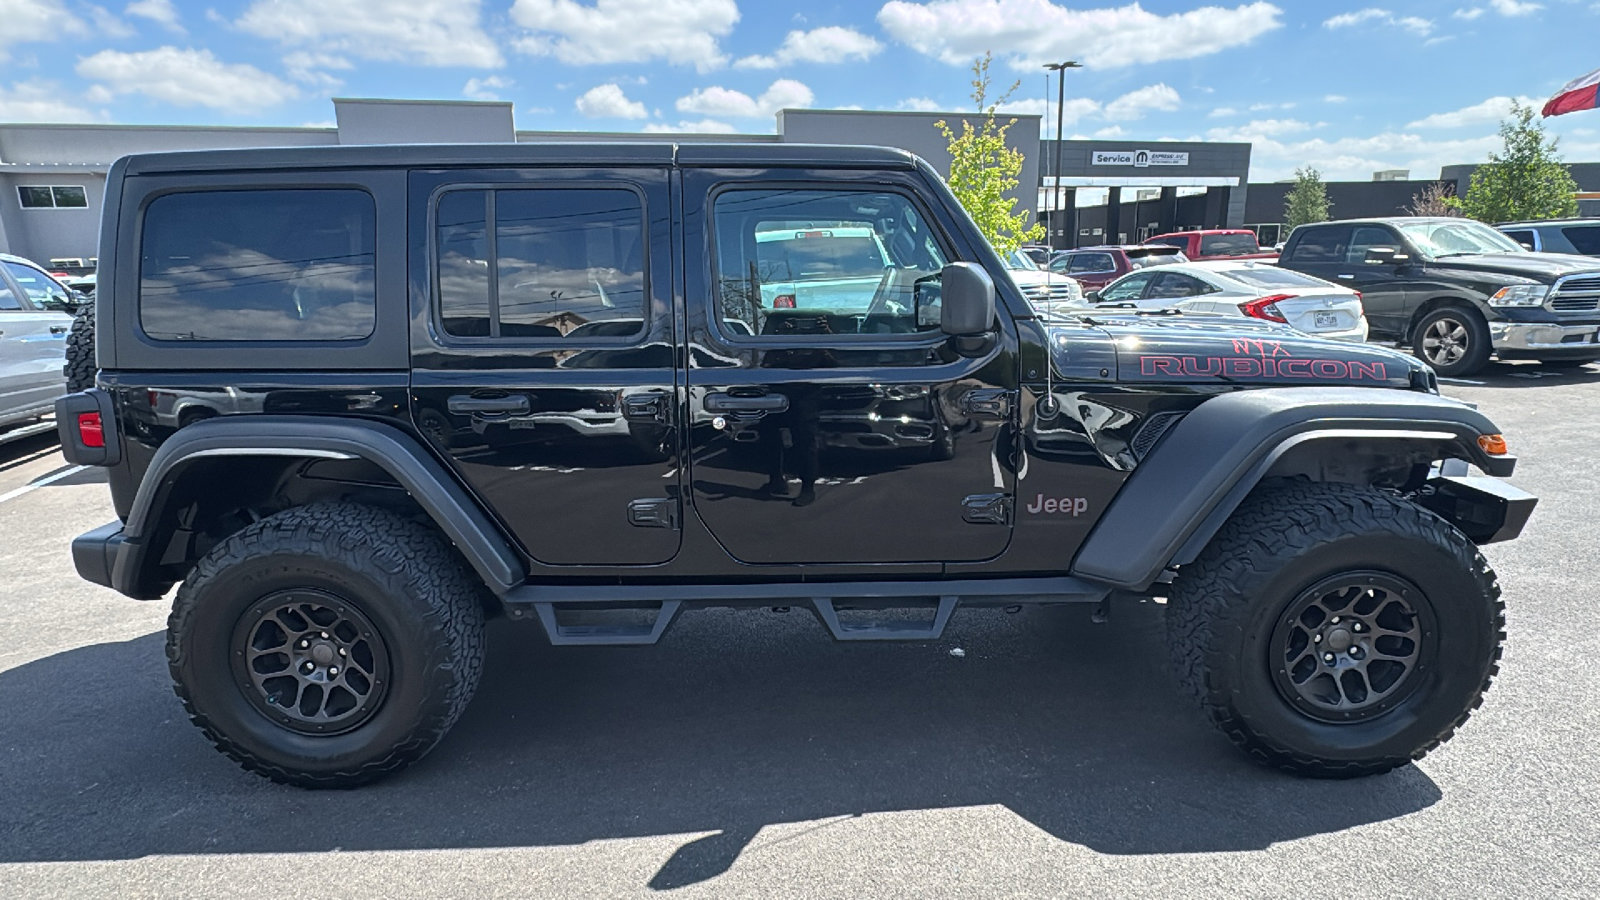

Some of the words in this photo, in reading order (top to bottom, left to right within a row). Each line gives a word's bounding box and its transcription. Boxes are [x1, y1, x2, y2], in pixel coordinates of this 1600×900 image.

[1097, 154, 1131, 163] Service
[1140, 356, 1387, 381] RUBICON
[1026, 493, 1088, 517] Jeep
